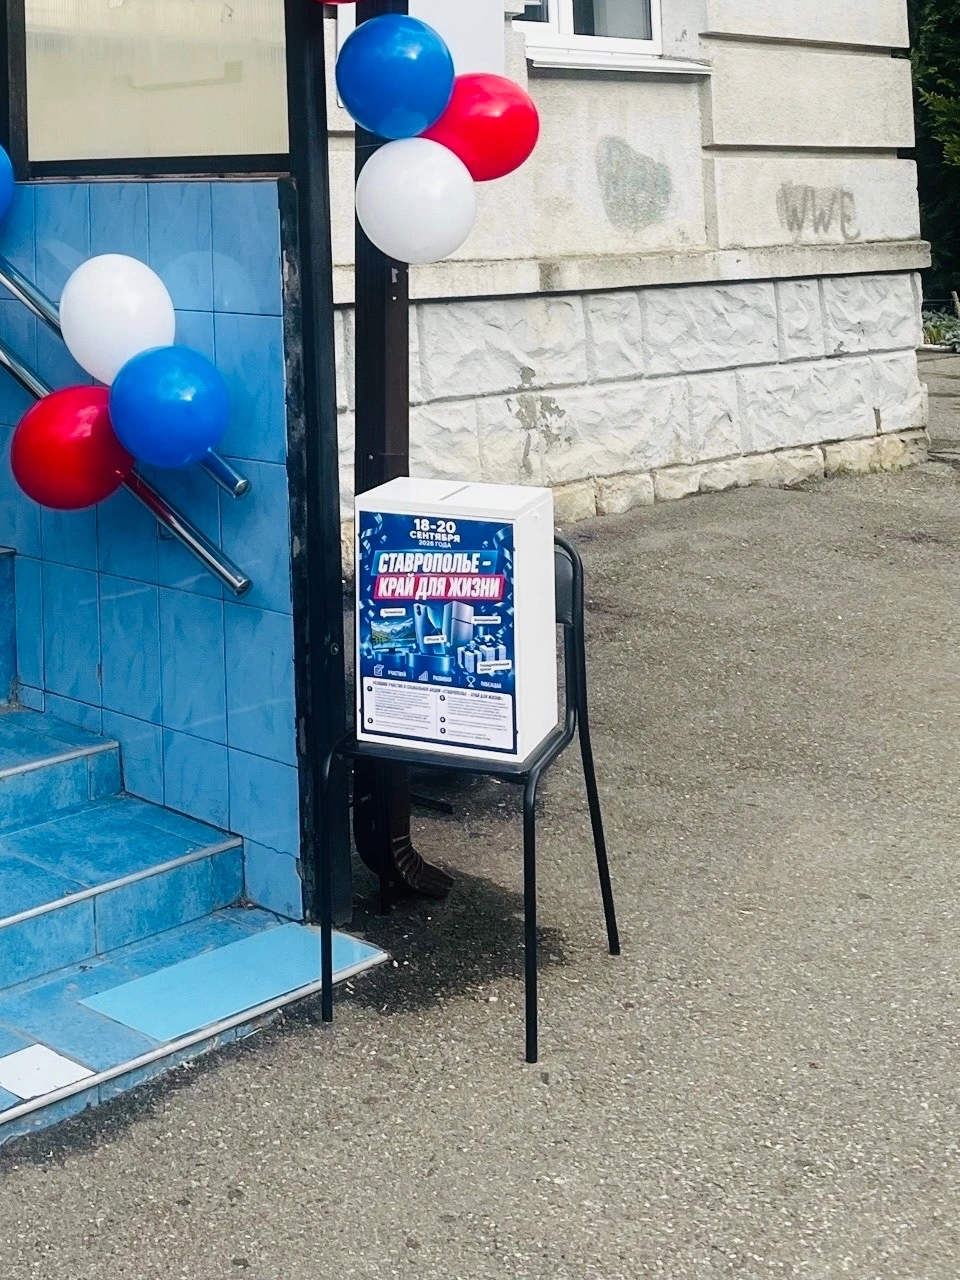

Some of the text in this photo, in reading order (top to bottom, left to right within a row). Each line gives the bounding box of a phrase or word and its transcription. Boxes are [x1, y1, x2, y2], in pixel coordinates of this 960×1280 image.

[413, 518, 456, 534] 18-20
[409, 530, 461, 543] СЕНТЯБРЯ
[434, 540, 452, 548] ГОДА
[378, 552, 481, 574] СТАВРОПОЛЬЕ
[377, 573, 501, 600] КРАЙ ДЛЯ ЖИЗНИ
